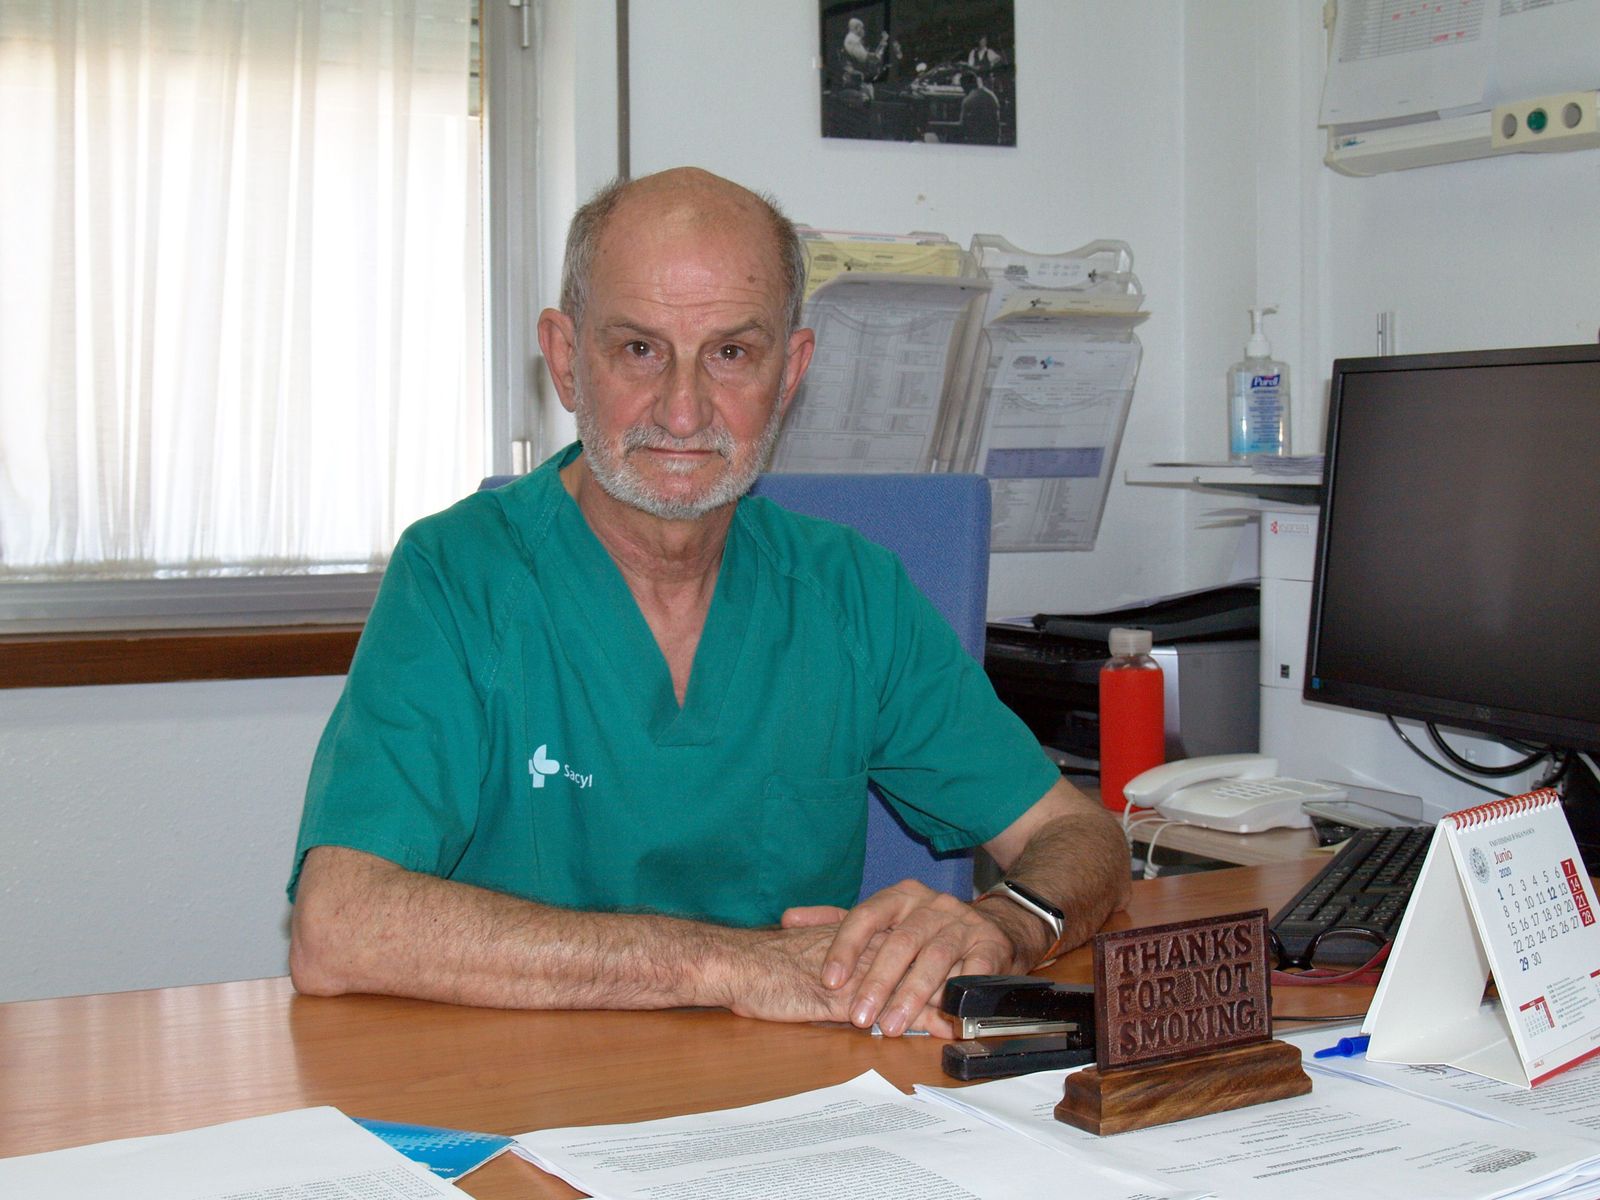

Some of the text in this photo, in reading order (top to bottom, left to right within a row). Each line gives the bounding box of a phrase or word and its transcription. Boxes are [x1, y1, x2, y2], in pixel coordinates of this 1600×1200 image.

[564, 764, 592, 788] Sacyl
[1494, 848, 1513, 865] Junio
[1498, 862, 1571, 900] 1 2 3 4 5 6 7
[1503, 876, 1580, 918] 8 9 10 11 12 13 14
[1508, 894, 1586, 936] 15 16 17 18 19 20 21
[1513, 910, 1593, 954] 22 23 24 25 26 27 28
[1115, 924, 1253, 978] THANKS
[1520, 952, 1542, 971] 29 30
[1117, 962, 1253, 1015] FOR NOT
[1120, 998, 1266, 1056] SMOKING.
